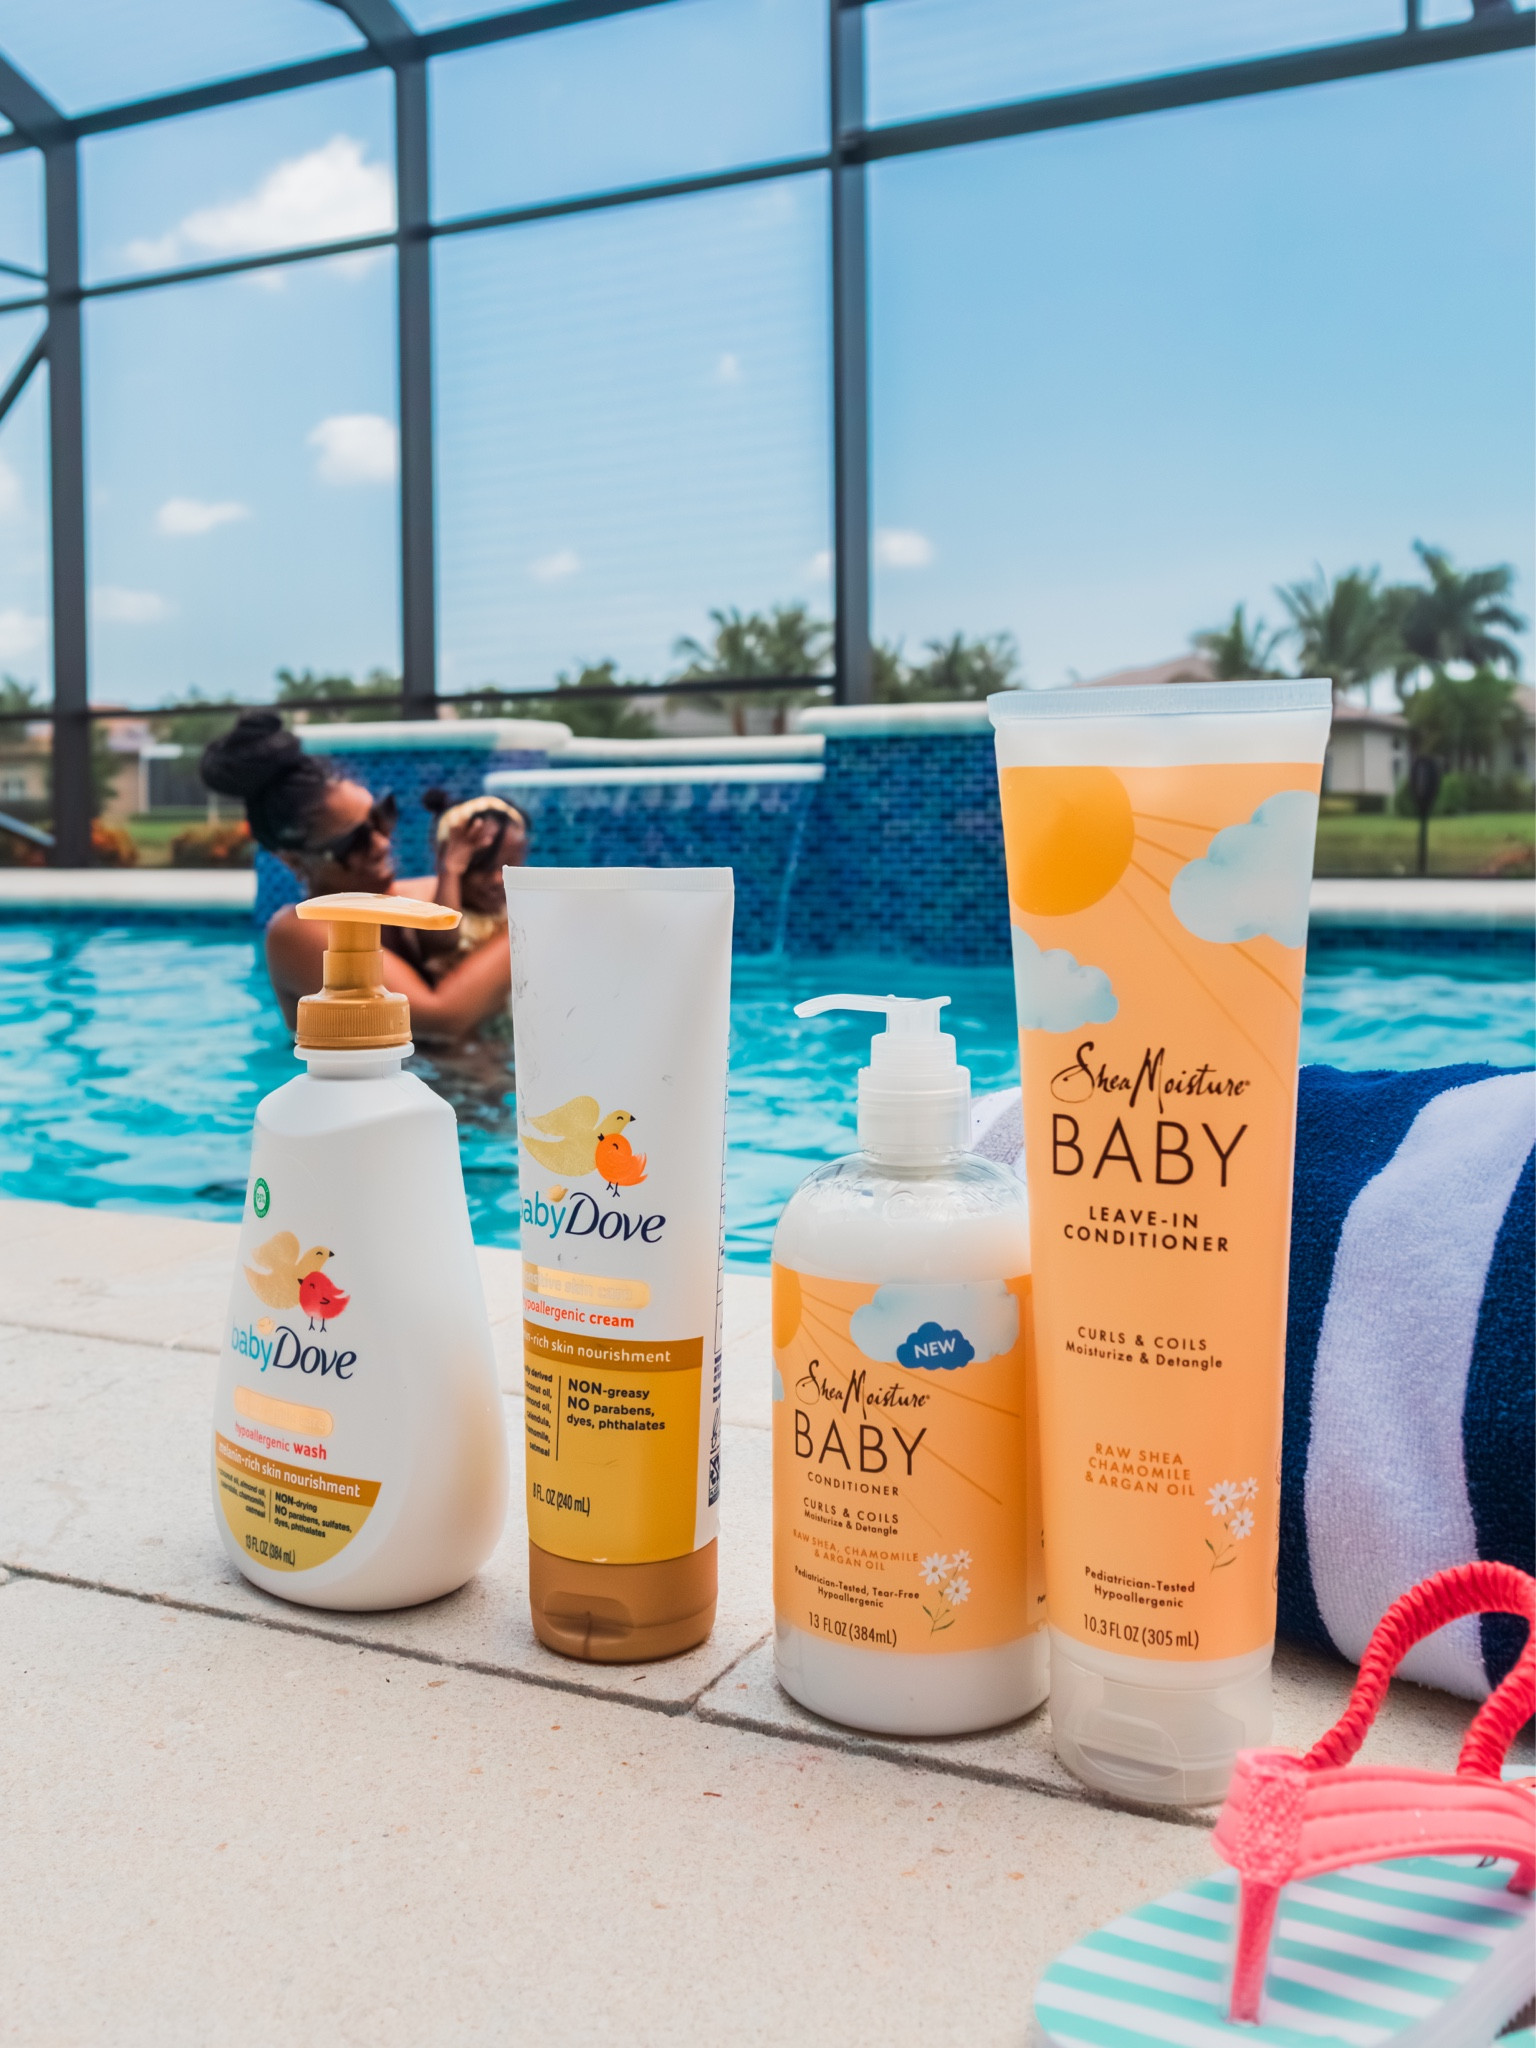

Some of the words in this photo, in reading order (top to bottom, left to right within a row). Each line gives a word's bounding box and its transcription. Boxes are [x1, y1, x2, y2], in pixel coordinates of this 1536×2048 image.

[1053, 1113, 1248, 1188] BABY
[1089, 1206, 1198, 1229] LEAVE-IN
[1064, 1224, 1228, 1252] CONDITIONER
[589, 1314, 634, 1328] cream
[552, 1339, 573, 1355] skin
[578, 1346, 671, 1363] nourishment
[914, 1338, 956, 1359] NEW
[1078, 1326, 1126, 1344] CURLS
[1135, 1334, 1145, 1346] &
[1154, 1336, 1207, 1351] COILS
[1066, 1340, 1133, 1362] Moisturize
[1139, 1352, 1149, 1364] &
[1156, 1354, 1223, 1372] Detangle
[568, 1378, 650, 1400] NON-greasy
[567, 1396, 590, 1411] NO
[593, 1403, 655, 1418] parabens,
[567, 1414, 595, 1429] dyes,
[598, 1419, 666, 1431] phthalates
[293, 1444, 327, 1460] wash
[795, 1409, 927, 1476] BABY
[1096, 1442, 1131, 1459] RAW
[1139, 1450, 1183, 1465] SHEA
[262, 1461, 281, 1480] skin
[283, 1470, 361, 1498] nourishment
[1088, 1456, 1191, 1481] CHAMOMILE
[808, 1471, 899, 1496] CONDITIONER
[1085, 1471, 1094, 1483] &
[1099, 1474, 1158, 1493] ARGAN
[1167, 1483, 1195, 1496] OIL
[275, 1491, 318, 1513] NON-drying
[546, 1488, 556, 1506] OZ
[574, 1496, 591, 1518] mL)
[803, 1497, 837, 1515] CURLS
[843, 1508, 850, 1518] &
[857, 1510, 899, 1524] COILS
[274, 1504, 287, 1516] NO
[288, 1510, 320, 1527] parabens,
[322, 1519, 352, 1533] sulfates,
[274, 1516, 290, 1530] dyes,
[290, 1522, 326, 1538] phthalates
[804, 1509, 843, 1528] Moisturize
[846, 1520, 852, 1530] &
[855, 1522, 898, 1537] Detangle
[793, 1529, 810, 1542] RAW
[812, 1537, 840, 1553] SHEA,
[844, 1545, 919, 1562] CHAMOMILE
[814, 1549, 820, 1558] &
[823, 1551, 861, 1567] ARGAN
[865, 1560, 885, 1571] OIL
[794, 1564, 870, 1596] Pediatrician-Tested,
[872, 1587, 920, 1599] Tear-Free
[1085, 1566, 1195, 1593] Pediatrician-Tested
[818, 1586, 884, 1608] Hypoallergenic
[1094, 1584, 1184, 1609] Hypoallergenic
[809, 1611, 820, 1629] 13
[823, 1616, 833, 1634] FL
[834, 1620, 847, 1637] OZ
[1084, 1613, 1107, 1635] 10.3
[1109, 1621, 1121, 1639] FL
[1123, 1625, 1139, 1642] OZ
[1142, 1627, 1173, 1647] (305
[1176, 1630, 1199, 1650] mL)
